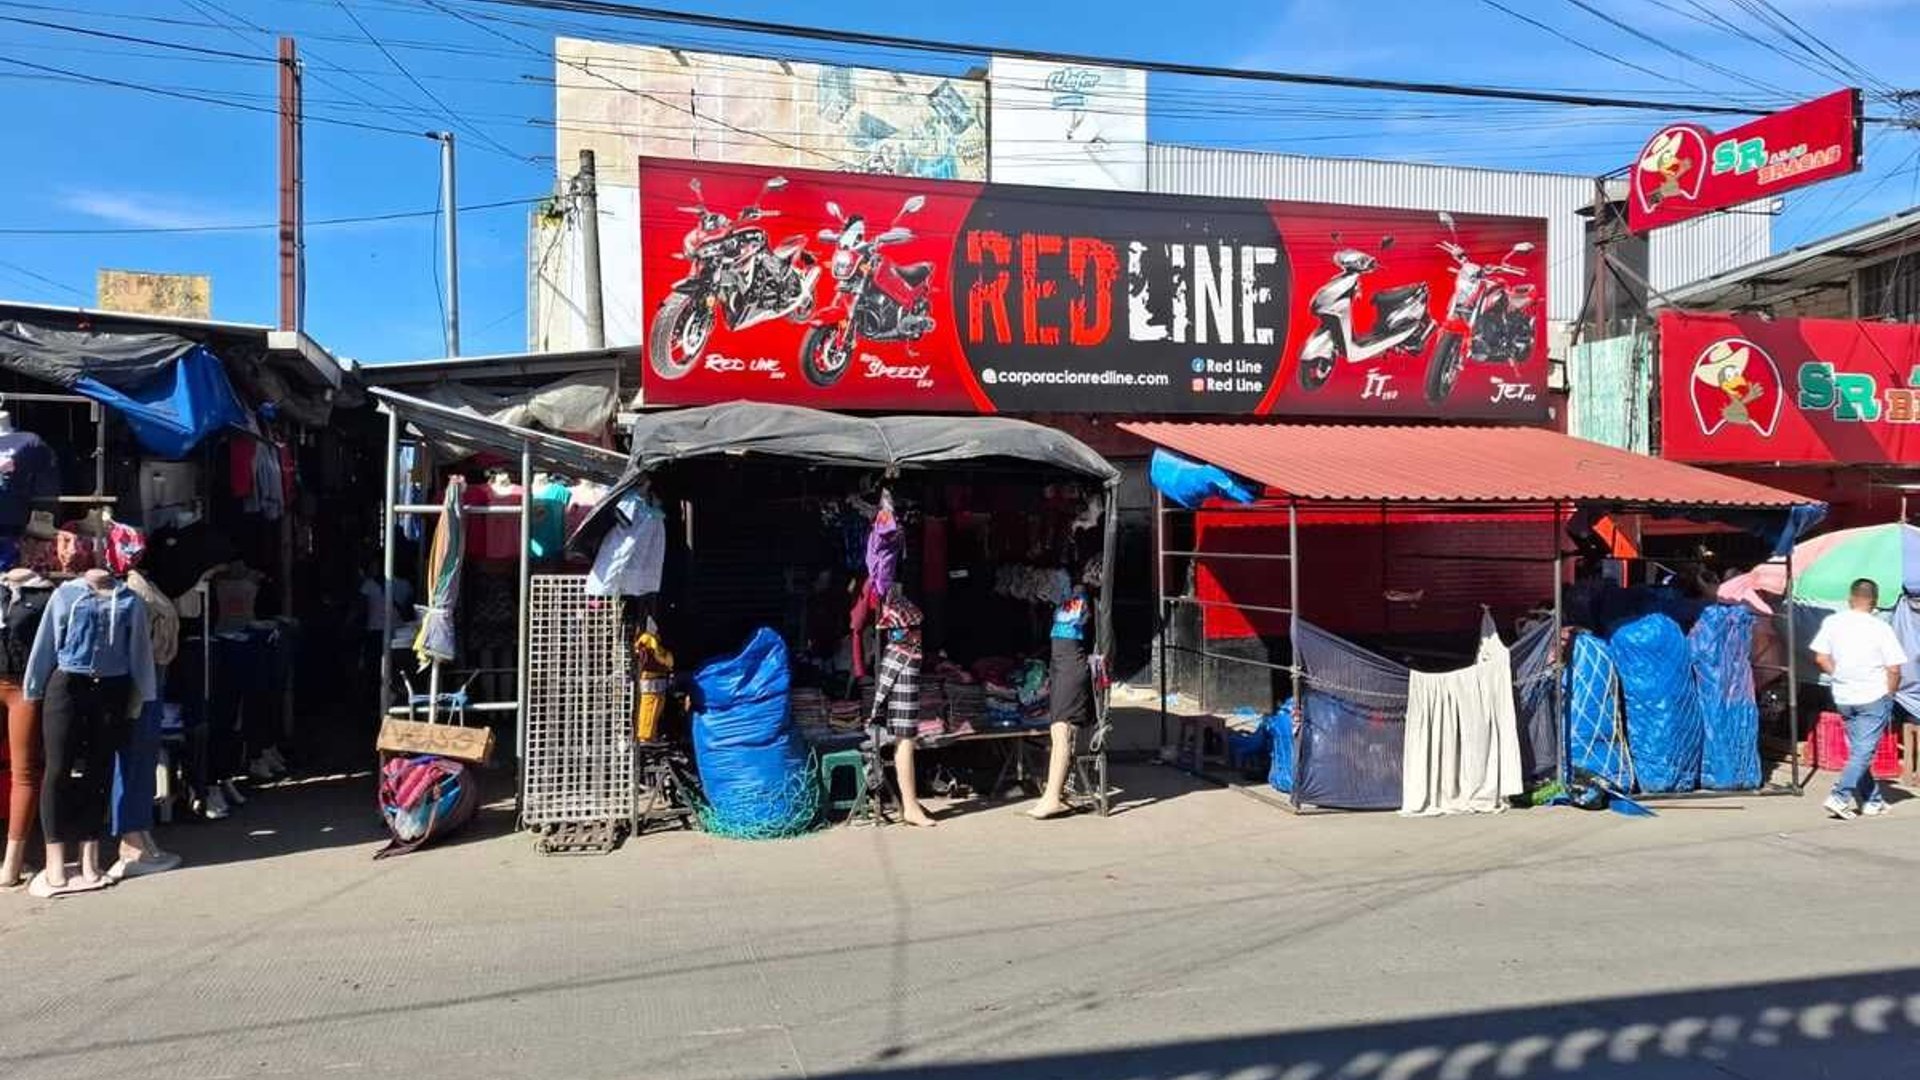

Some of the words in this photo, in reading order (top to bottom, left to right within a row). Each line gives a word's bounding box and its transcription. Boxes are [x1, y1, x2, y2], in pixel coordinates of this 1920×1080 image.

[1712, 137, 1768, 175] SR
[1207, 359, 1233, 373] Red
[1236, 359, 1263, 374] Line
[998, 369, 1169, 390] corporacionredline.com
[1208, 377, 1233, 392] Red
[1236, 378, 1264, 393] Line
[1490, 383, 1530, 403] JET
[1798, 362, 1882, 422] SR
